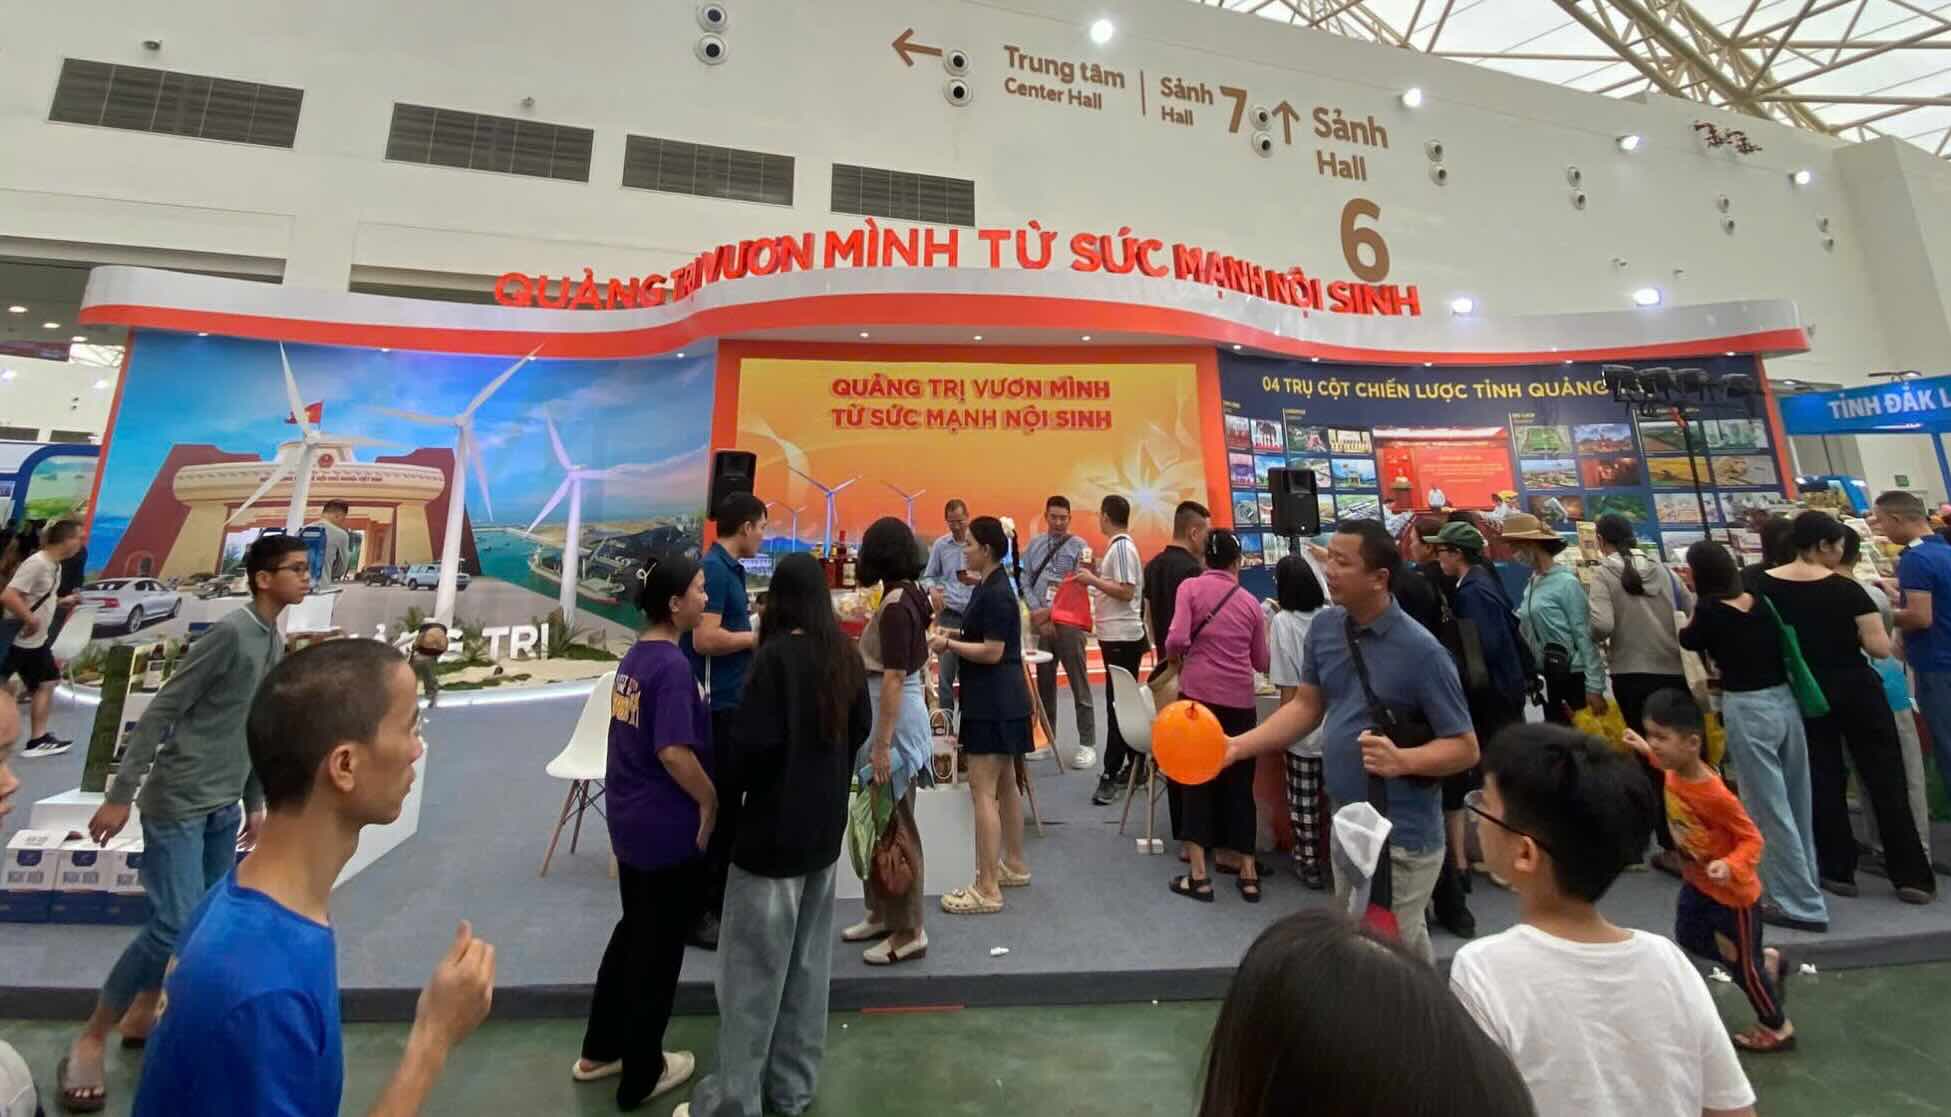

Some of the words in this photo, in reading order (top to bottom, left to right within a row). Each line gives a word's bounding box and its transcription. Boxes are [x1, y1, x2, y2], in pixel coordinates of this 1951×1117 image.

[1003, 45, 1074, 84] Trung
[1080, 62, 1125, 89] tâm
[1004, 77, 1064, 102] Center
[1068, 88, 1103, 110] Hall
[1160, 77, 1214, 105] Sảnh
[1219, 85, 1247, 133] 7
[1161, 106, 1194, 126] Hall
[1312, 107, 1389, 149] Sảnh
[1316, 150, 1367, 181] Hall
[1340, 198, 1391, 283] 6
[495, 267, 667, 312] QUẢNG
[701, 231, 815, 284] VƯƠN
[824, 217, 959, 268] MÌNH
[978, 220, 1058, 269] TỪ
[1070, 226, 1169, 278] SỨC
[1172, 243, 1267, 299] MẠNH
[1265, 266, 1324, 318] NỘI
[1327, 281, 1422, 317] SINH
[832, 373, 921, 398] QUẢNG
[928, 379, 966, 401] TRỊ
[973, 377, 1043, 398] VƯƠN
[1049, 376, 1110, 398] MÌNH
[1262, 375, 1280, 392] 04
[1284, 378, 1312, 399] TRỤ
[1318, 377, 1349, 400] CỘT
[1355, 378, 1411, 399] CHIẾN
[1416, 382, 1468, 403] LƯỢC
[1472, 379, 1522, 399] TỈNH
[832, 403, 865, 427] TỪ
[871, 404, 919, 427] SỨC
[927, 408, 997, 432] MẠNH
[1006, 404, 1048, 433] NỘI
[1056, 410, 1112, 429] SINH
[1827, 393, 1882, 420] TỈNH
